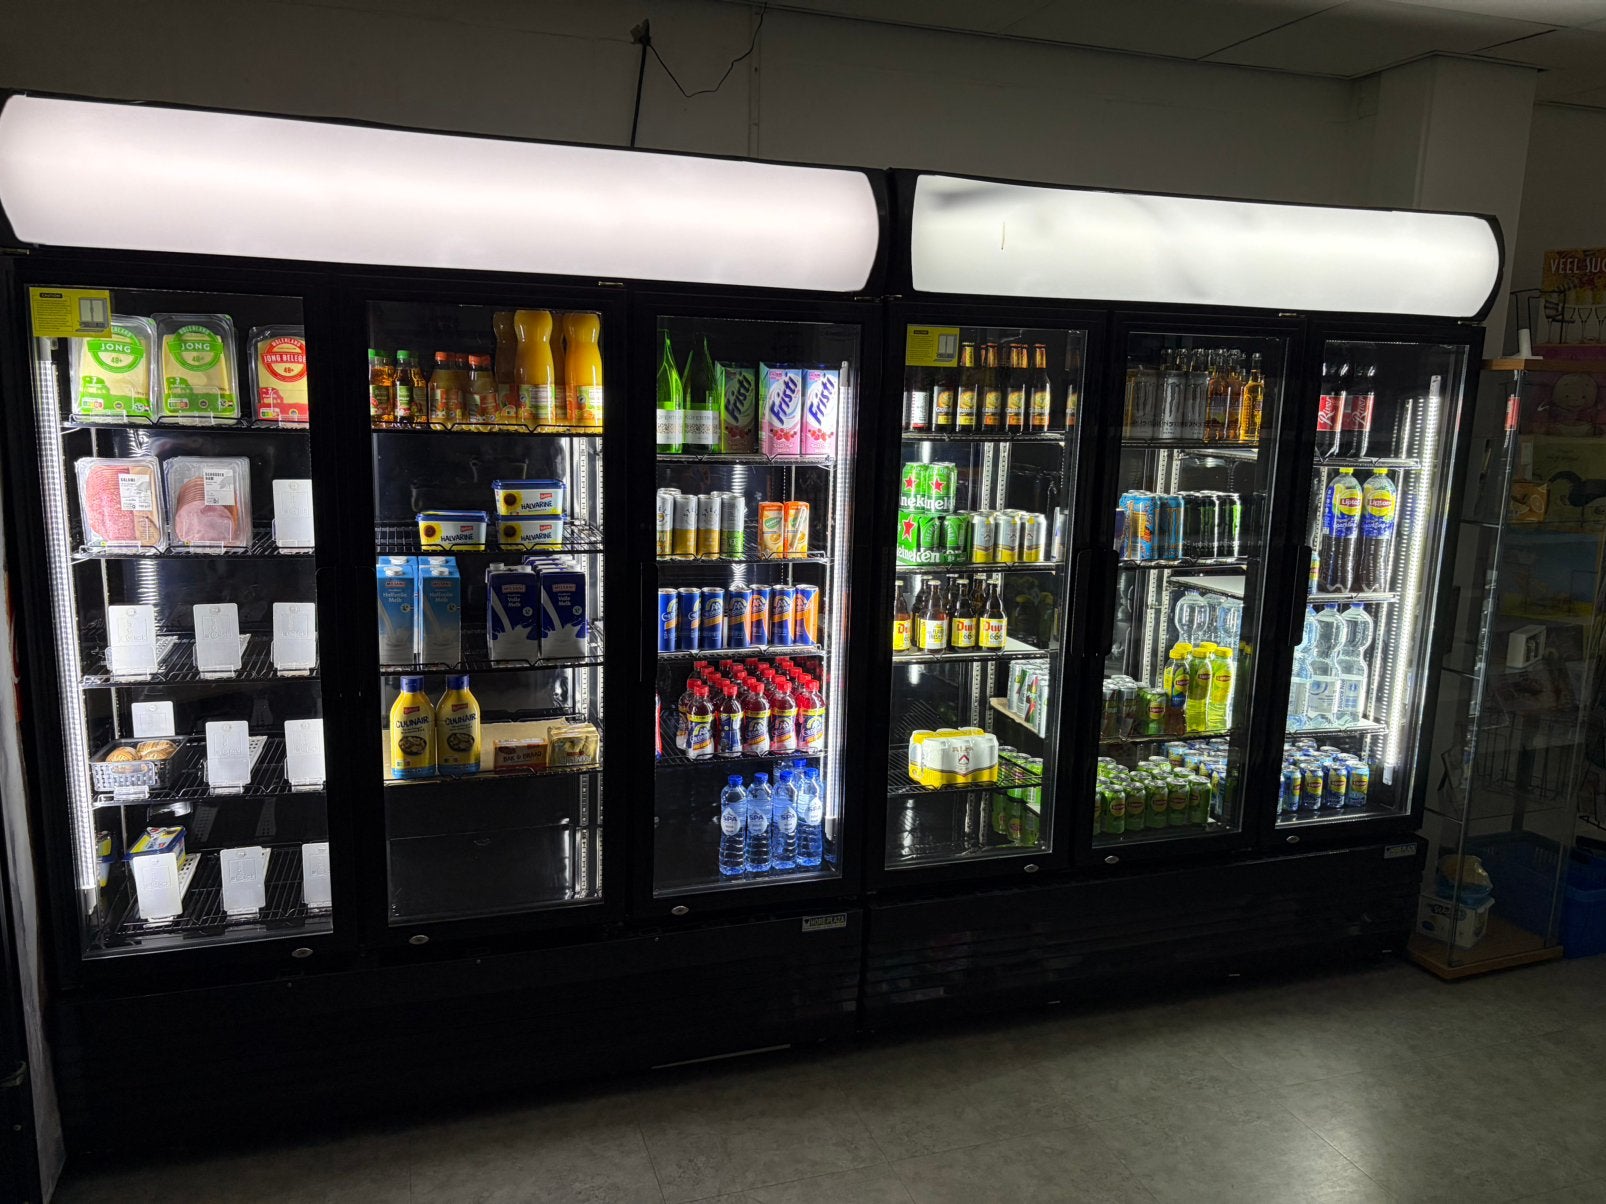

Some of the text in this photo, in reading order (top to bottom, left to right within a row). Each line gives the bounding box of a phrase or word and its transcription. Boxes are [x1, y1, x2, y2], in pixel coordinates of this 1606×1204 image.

[1550, 258, 1580, 274] VEEL
[100, 343, 132, 353] JONG
[181, 342, 211, 350] JONG
[264, 355, 282, 363] JONG
[771, 371, 798, 426] Fristi
[809, 372, 835, 426] Fristi
[521, 501, 553, 510] HALVARINE
[1369, 499, 1392, 507] Lipton
[441, 534, 474, 542] HALVARINE
[521, 533, 552, 541] HALVARINE
[396, 715, 429, 728] CULINAIR
[446, 713, 476, 726] CULINAIR
